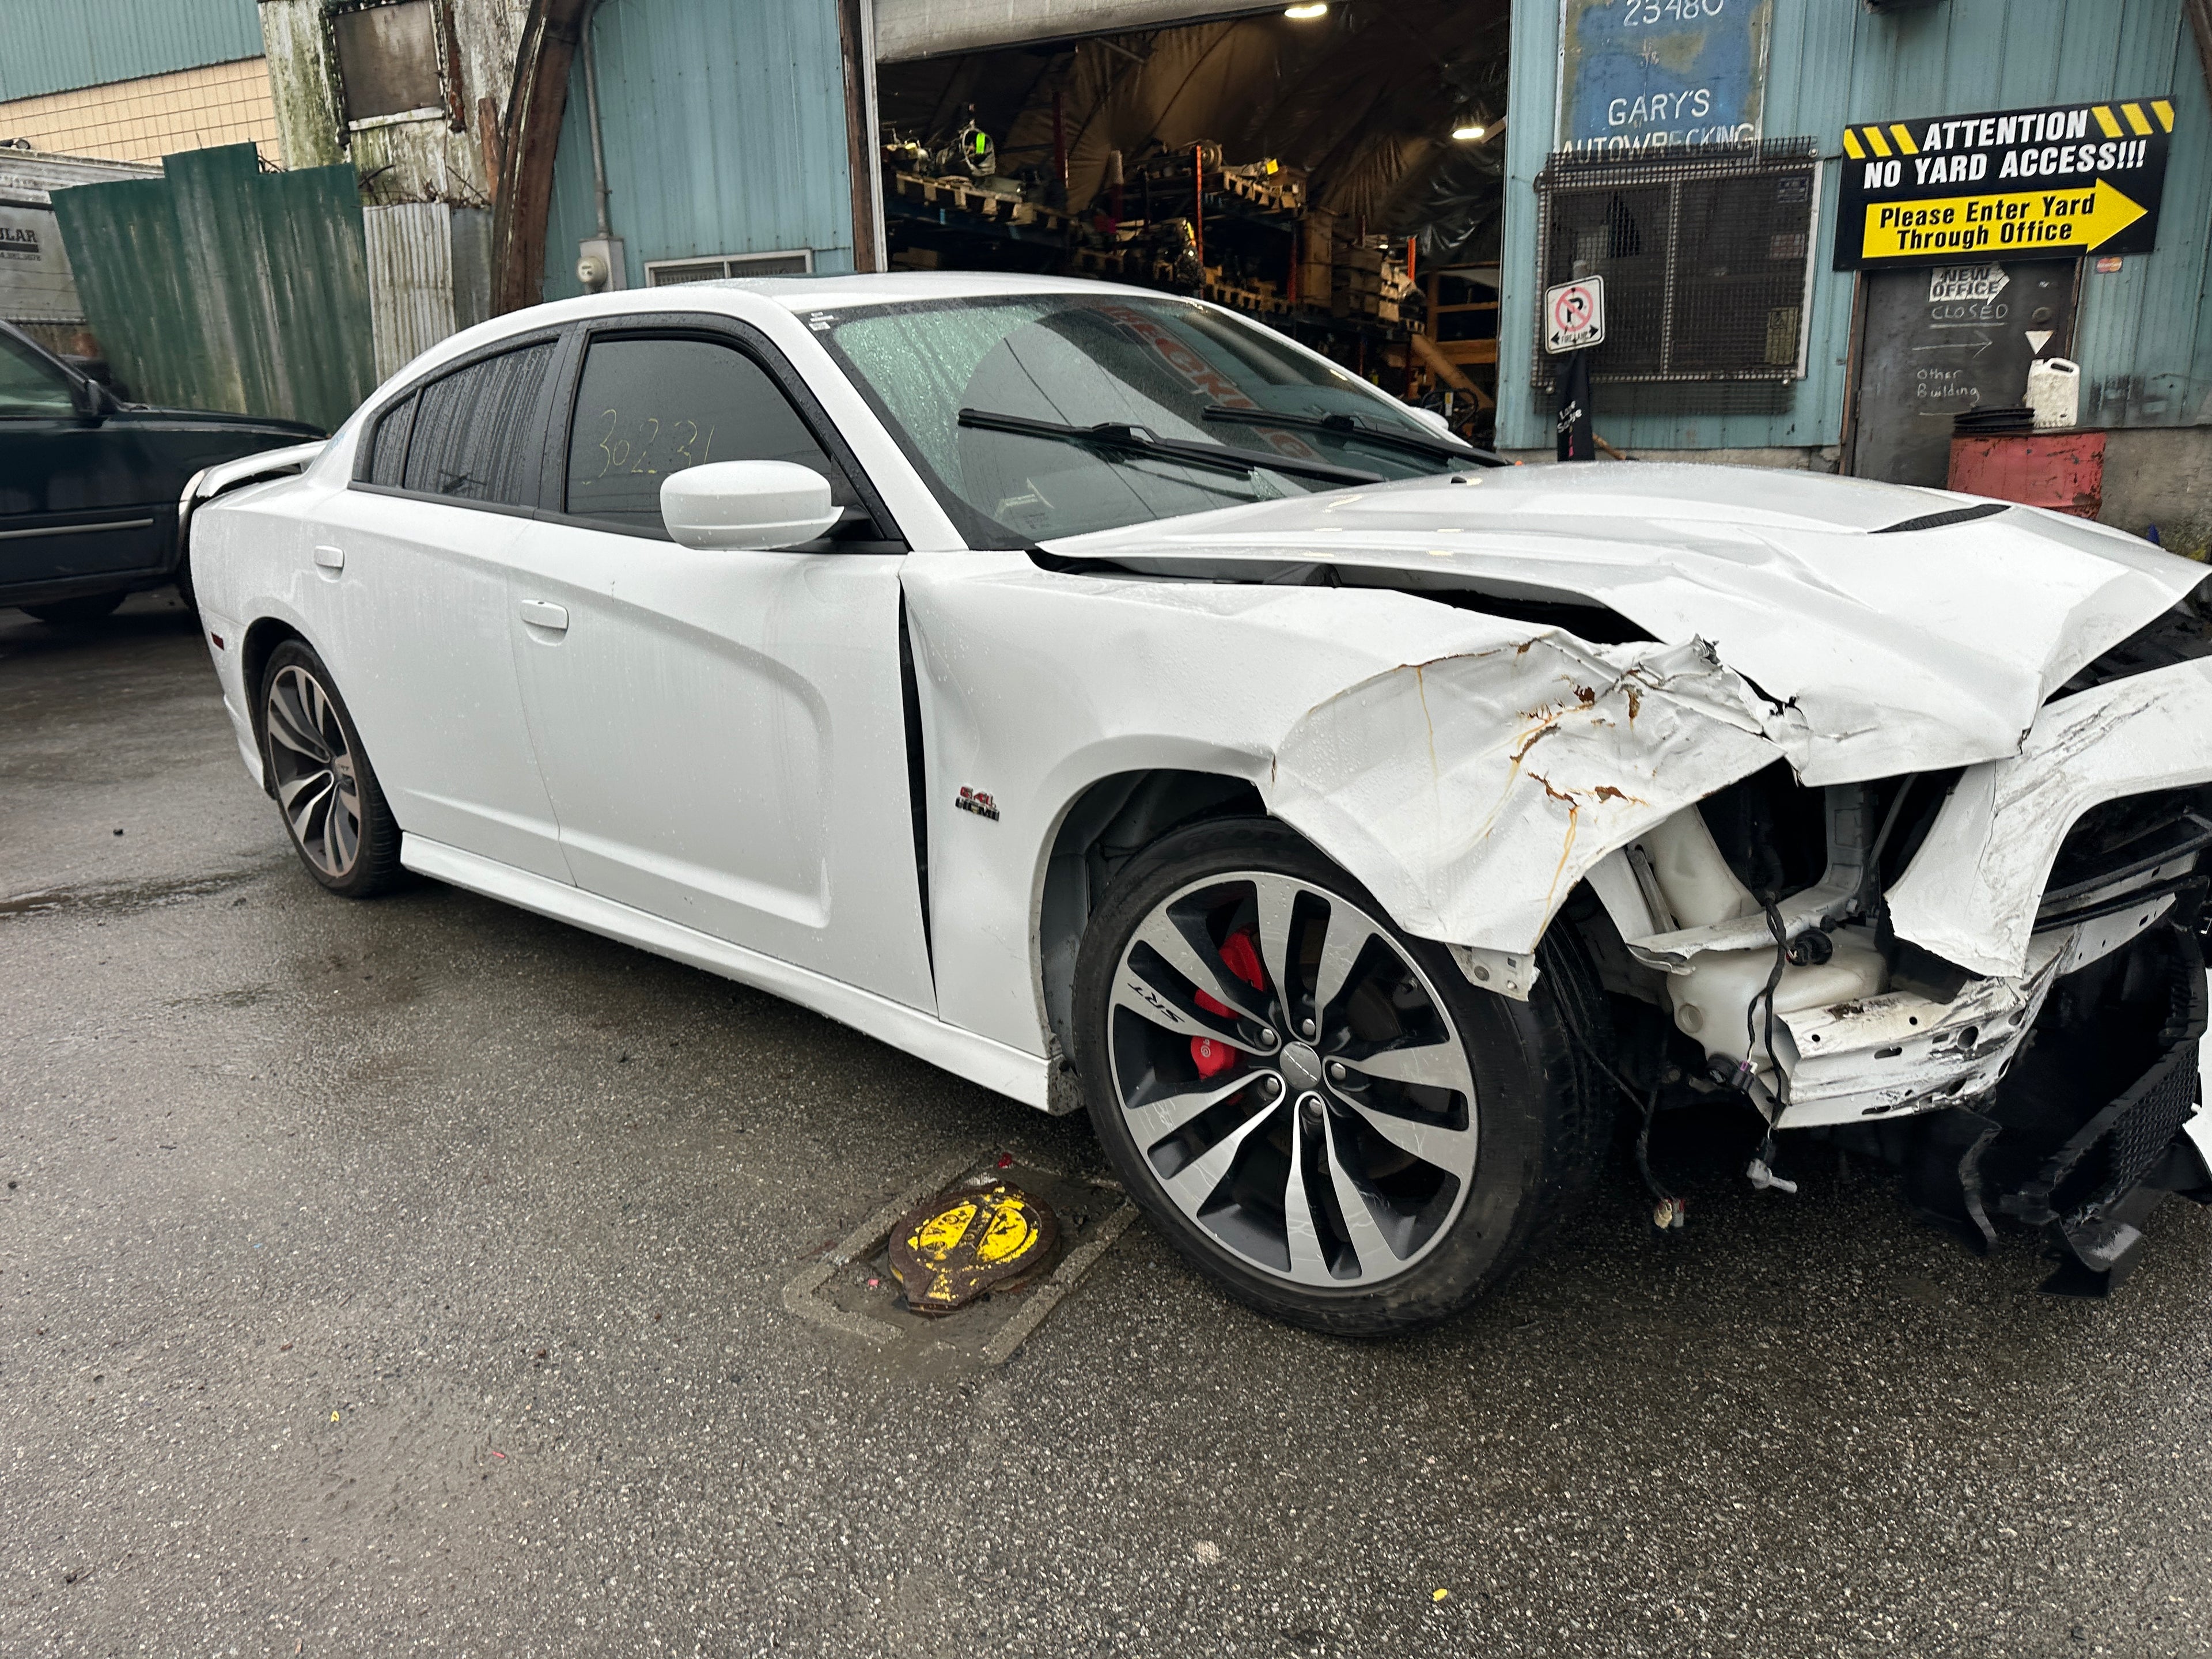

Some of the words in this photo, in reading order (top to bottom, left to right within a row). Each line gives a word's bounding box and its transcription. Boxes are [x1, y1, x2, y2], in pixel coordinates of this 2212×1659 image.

[1608, 89, 1710, 126] GARY'S
[1922, 109, 2089, 152] ATTENTION
[1863, 160, 1902, 190] NO
[1914, 153, 1988, 185] YARD
[1998, 139, 2147, 179] ACCESS!!!
[1880, 207, 1955, 229] Please
[1966, 199, 2031, 223] Enter
[2043, 193, 2095, 218] Yard
[1897, 224, 1989, 249] Through
[2001, 220, 2072, 243] Office
[1933, 280, 1999, 297] OFFICE
[1932, 304, 2009, 320] CLOSED
[1917, 382, 1980, 403] Building
[1127, 983, 1185, 1023] SRT
